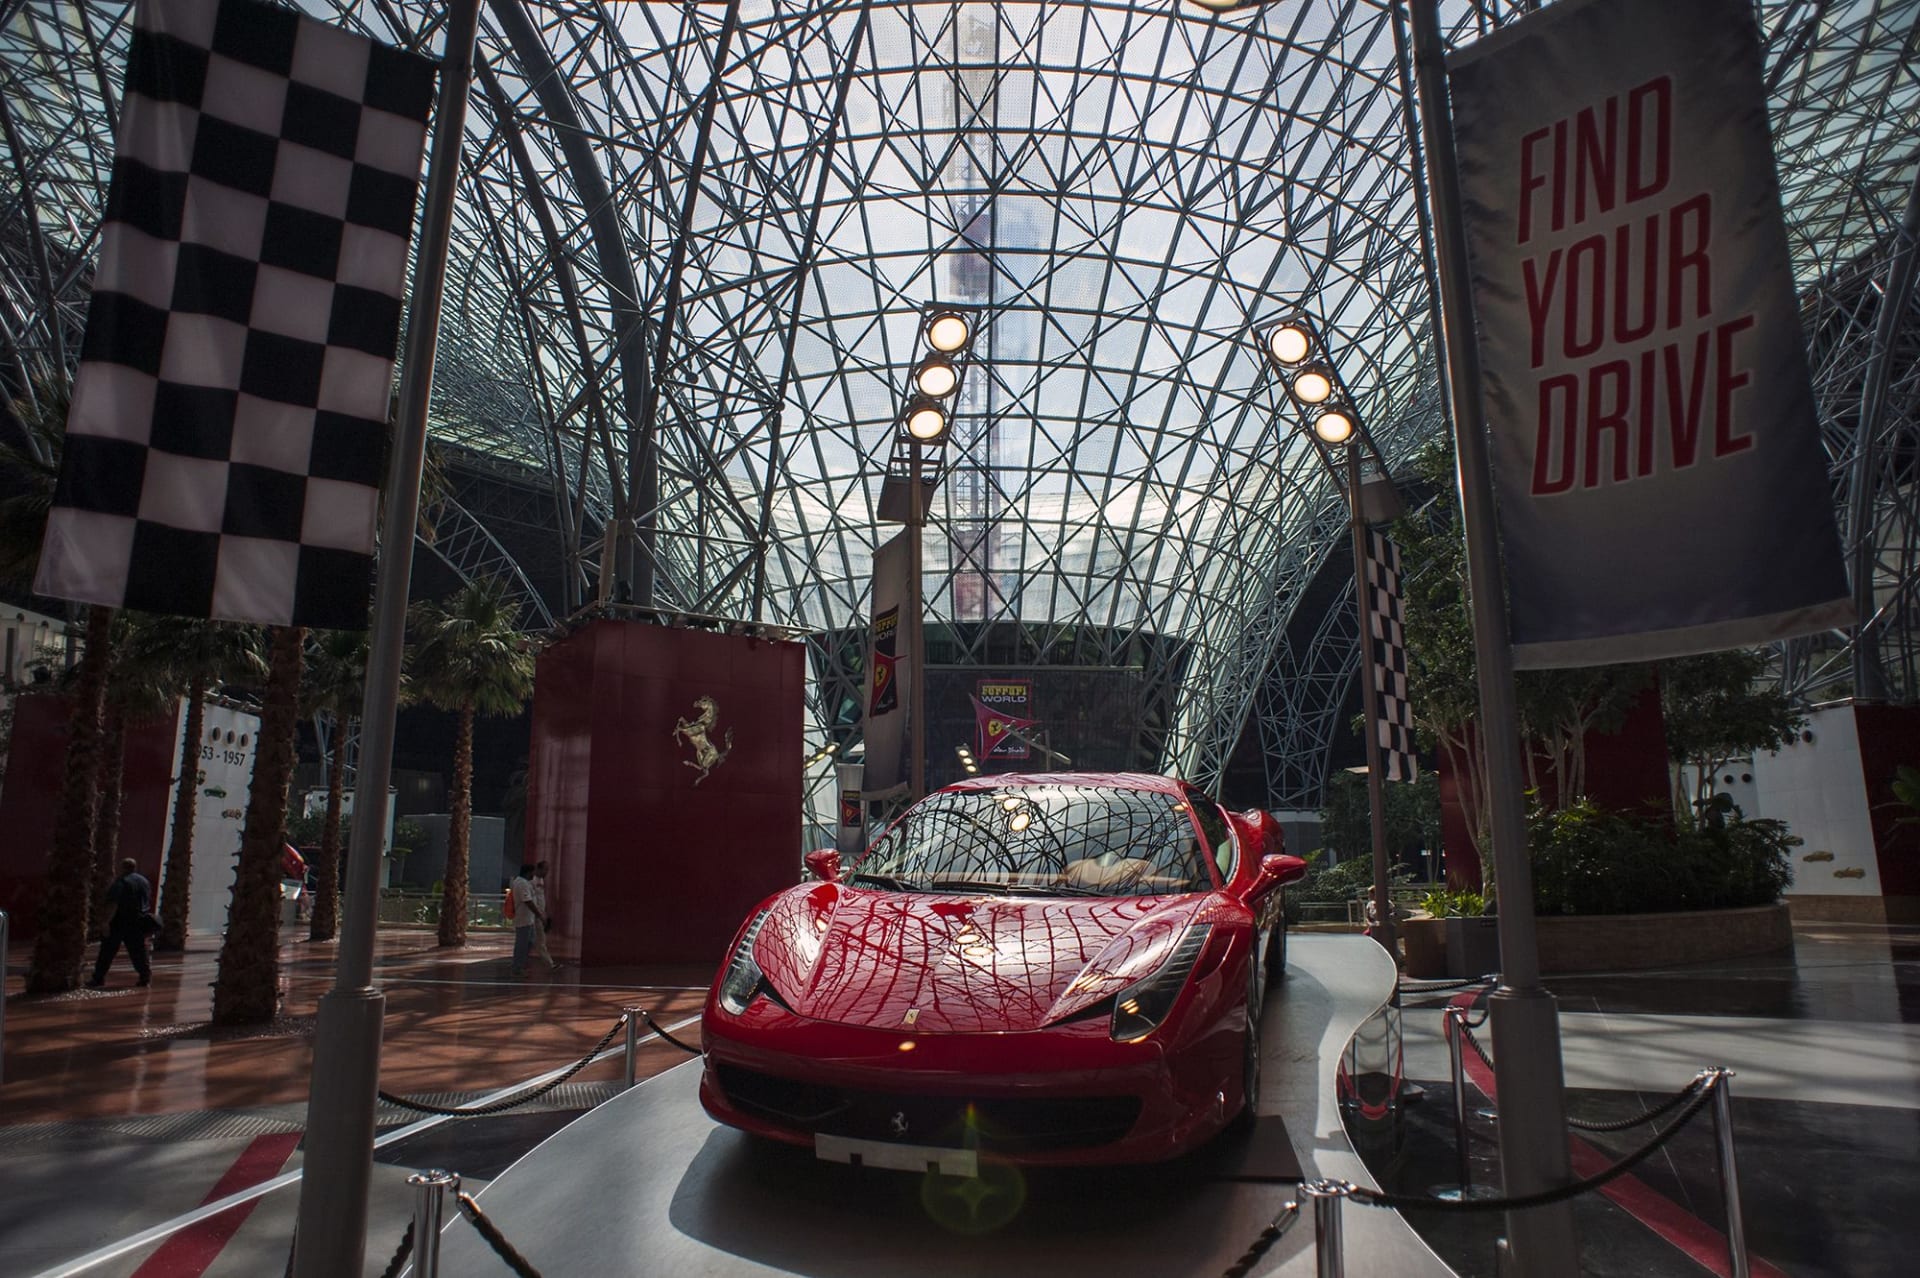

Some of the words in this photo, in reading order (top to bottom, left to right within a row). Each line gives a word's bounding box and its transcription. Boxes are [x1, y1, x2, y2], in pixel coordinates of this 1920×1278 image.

[1518, 75, 1672, 245] FIND
[1522, 193, 1712, 369] YOUR
[1529, 315, 1755, 496] DRIVE
[223, 750, 245, 766] 1957
